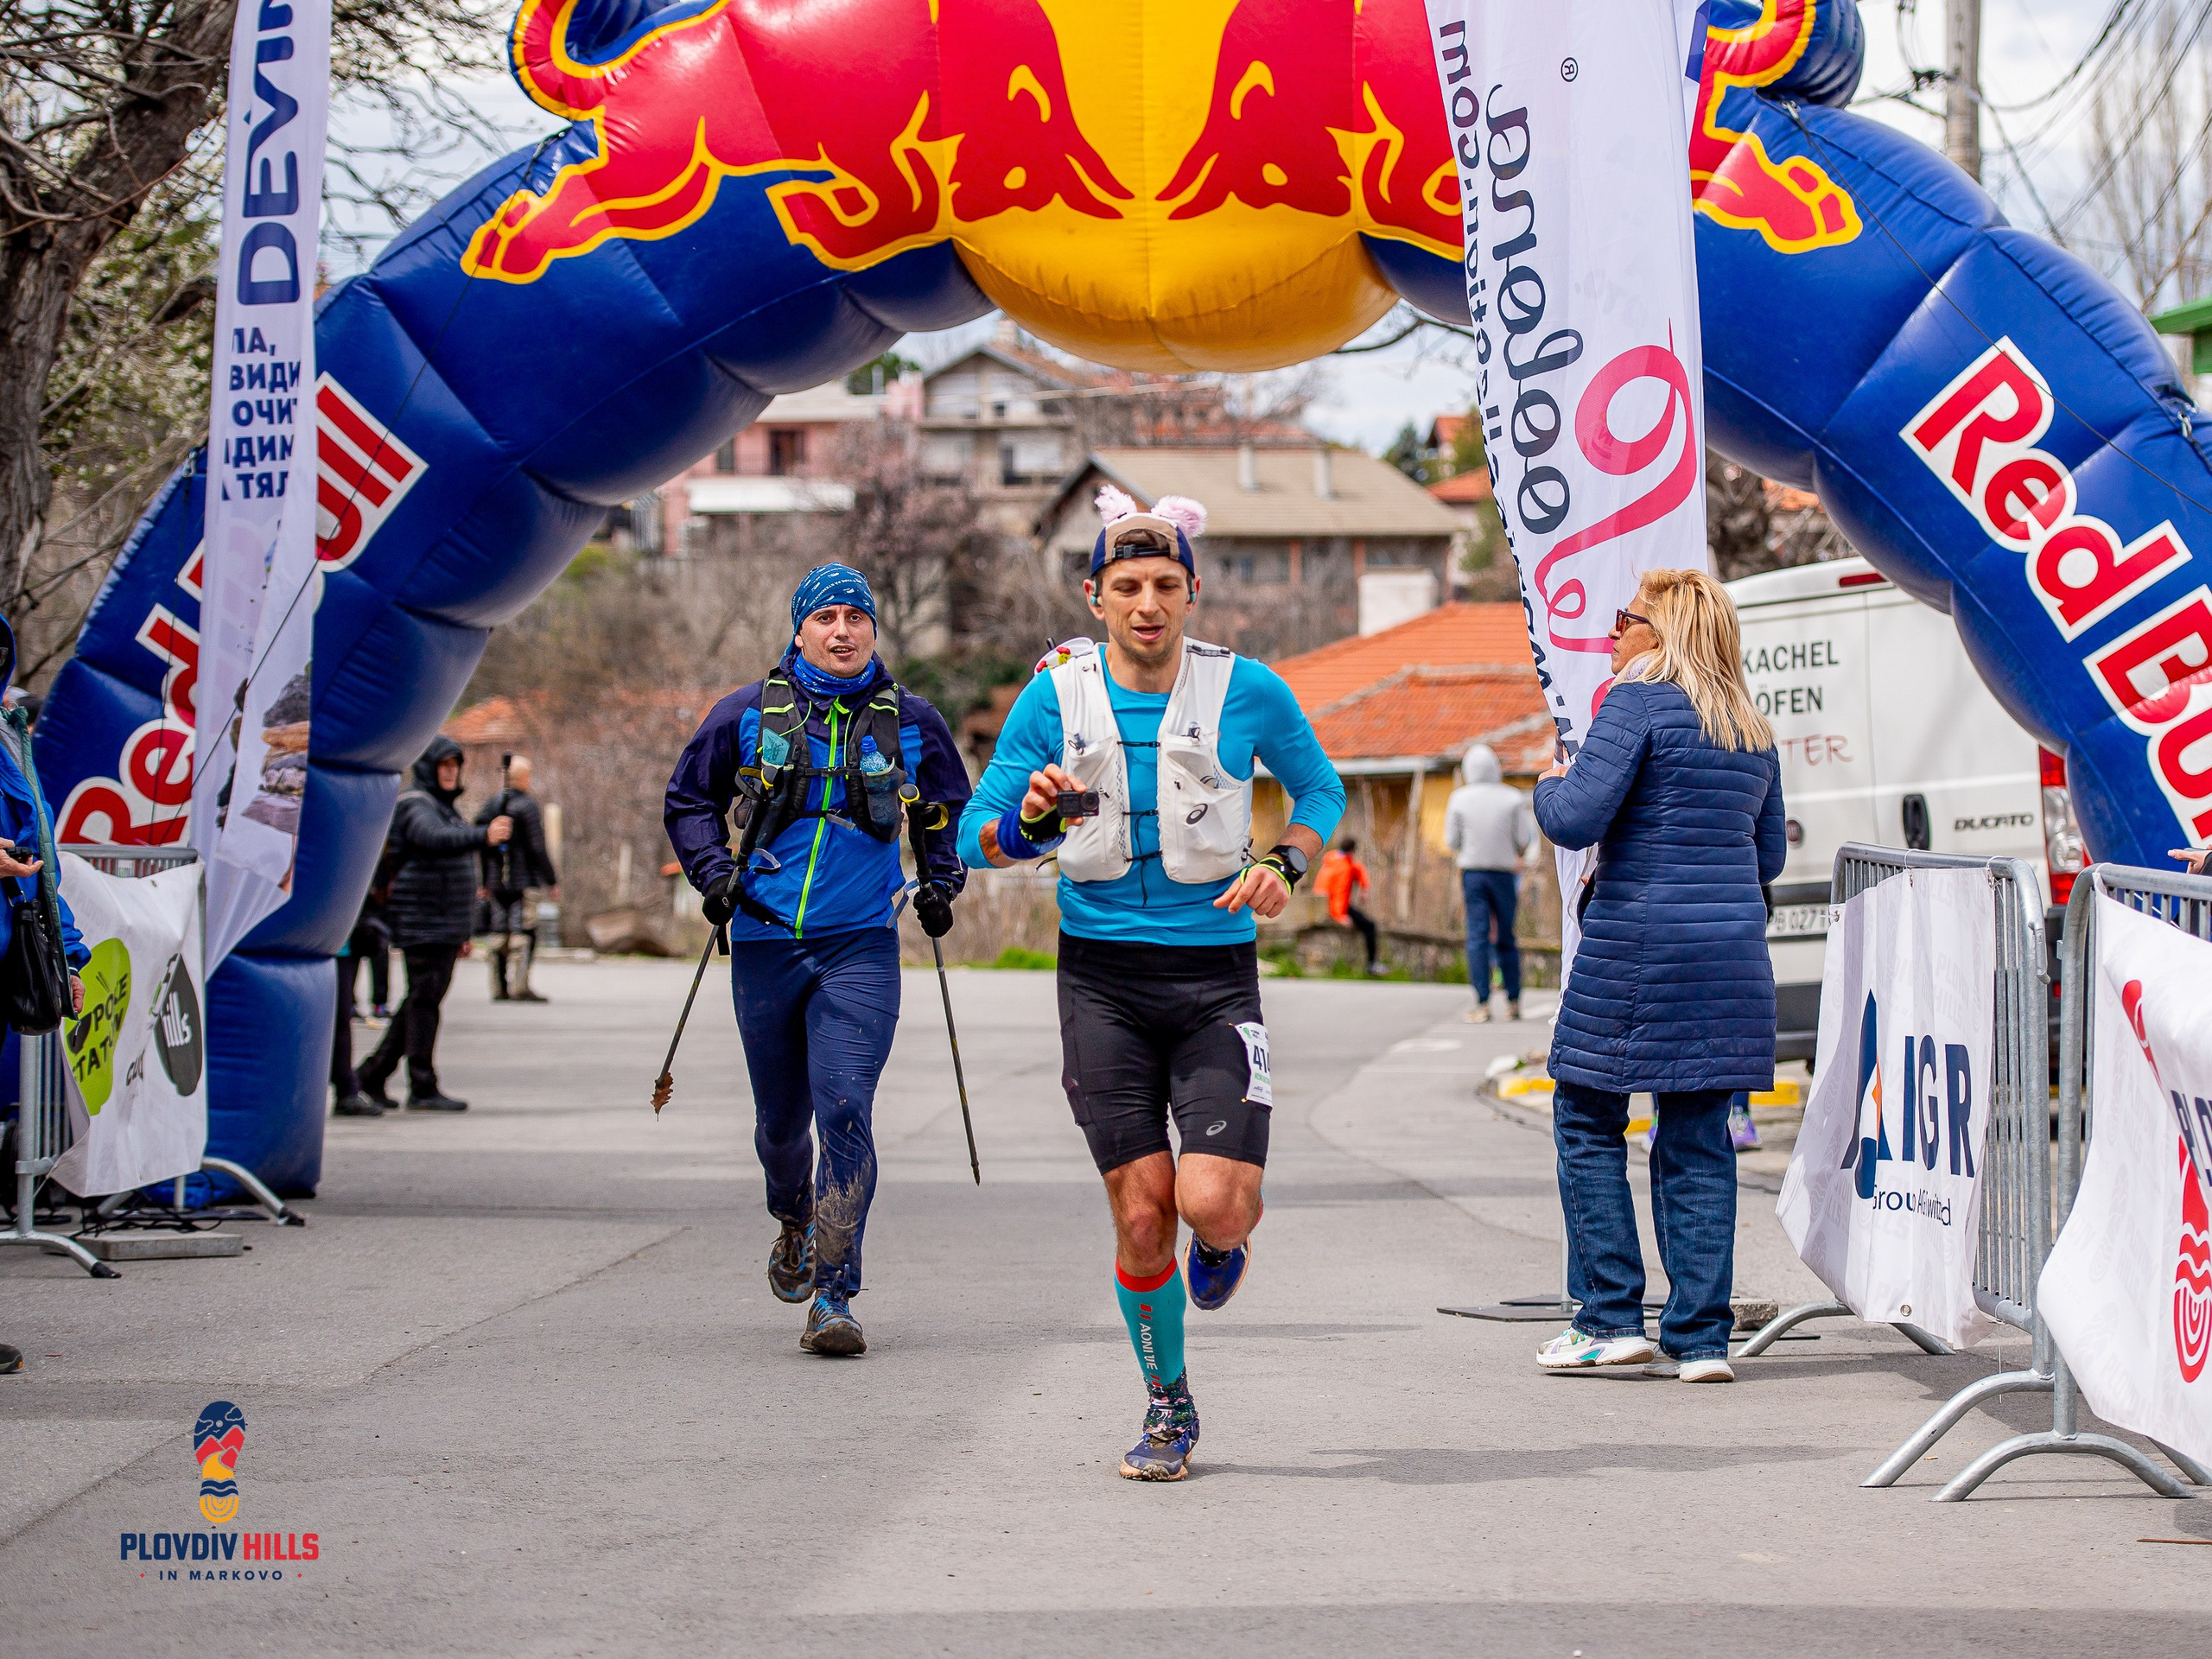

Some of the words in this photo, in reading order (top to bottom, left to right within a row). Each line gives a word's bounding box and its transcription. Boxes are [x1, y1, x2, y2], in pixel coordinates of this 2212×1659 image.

[231, 397, 298, 428] ОЧИ
[223, 434, 295, 468] ДИМ
[1912, 351, 2178, 627] Red
[1742, 640, 1840, 674] KACHEL
[1756, 683, 1823, 717] ÖFEN
[1955, 814, 2034, 831] DUCATO
[162, 990, 194, 1049] ills
